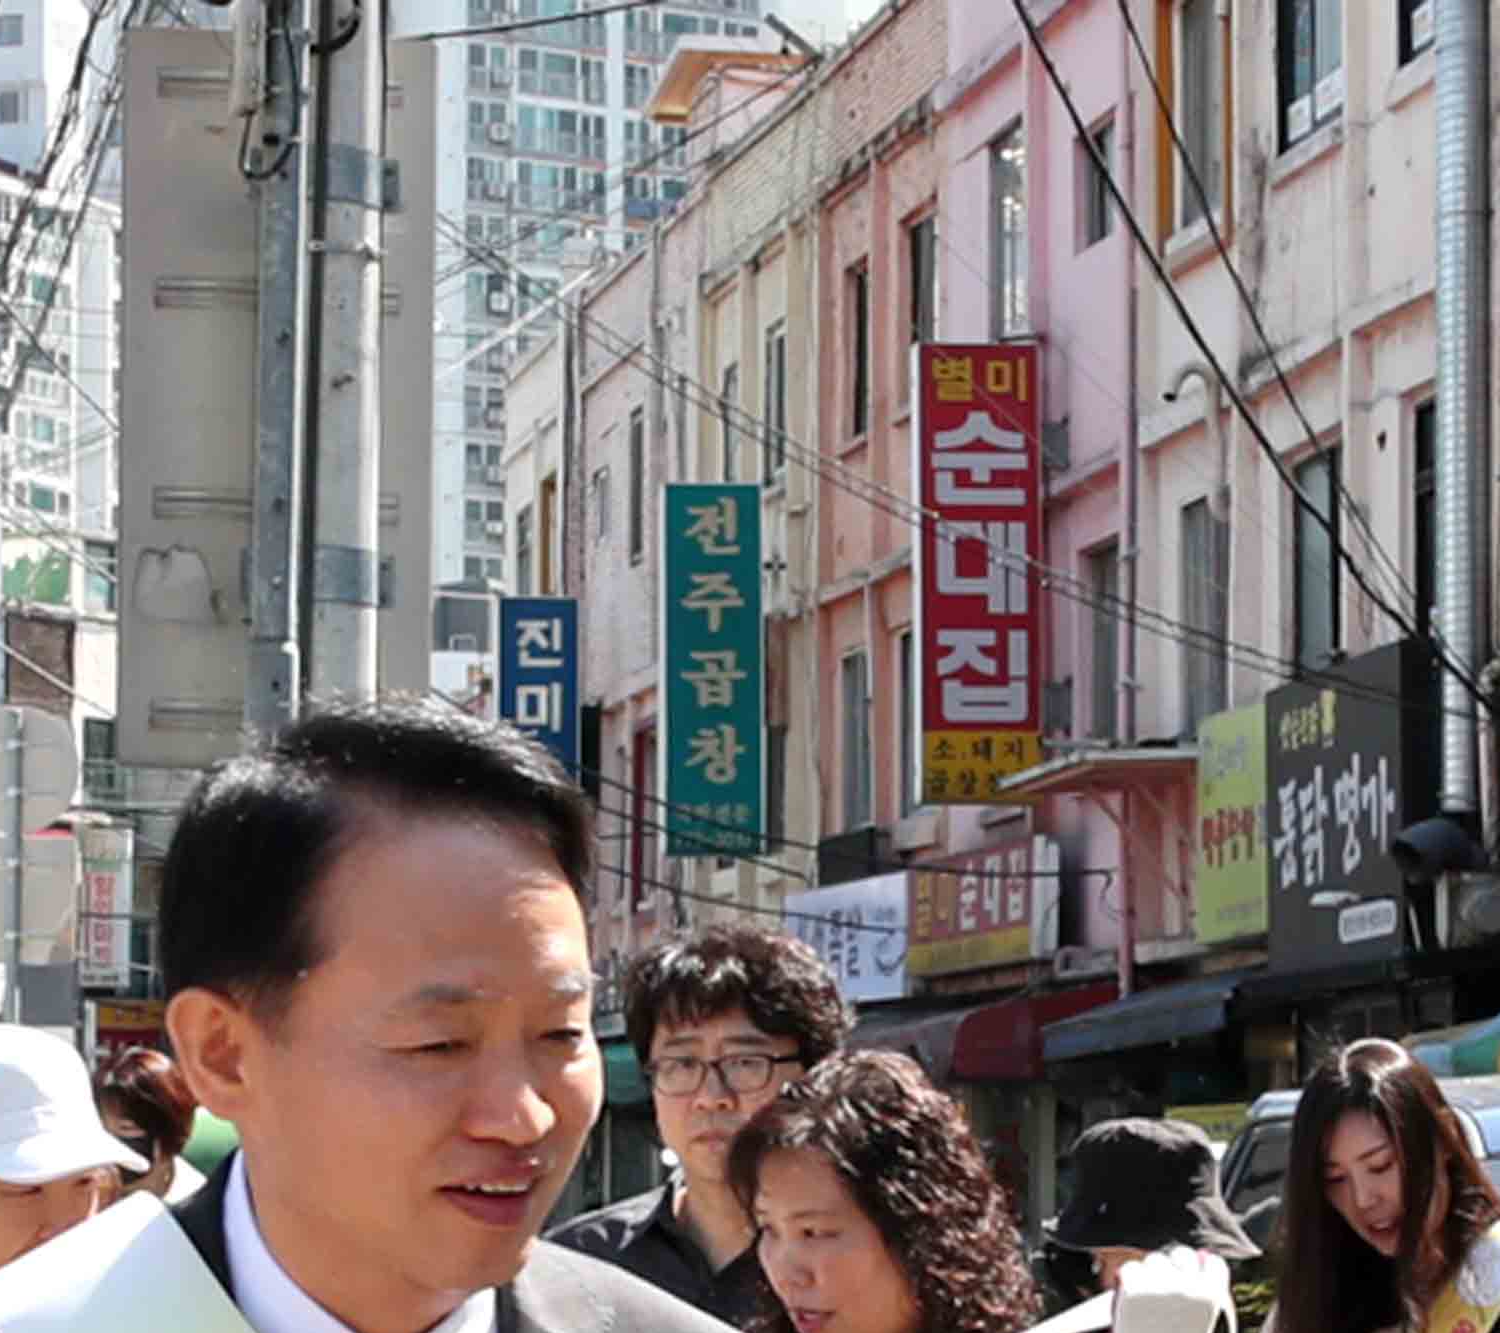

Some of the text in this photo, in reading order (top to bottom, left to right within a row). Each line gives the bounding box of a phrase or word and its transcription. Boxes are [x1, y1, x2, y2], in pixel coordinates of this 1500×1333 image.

[930, 356, 1028, 402] 별미
[678, 496, 747, 785] 전주곱창
[930, 408, 1028, 725] 순대집
[514, 617, 565, 733] 진미
